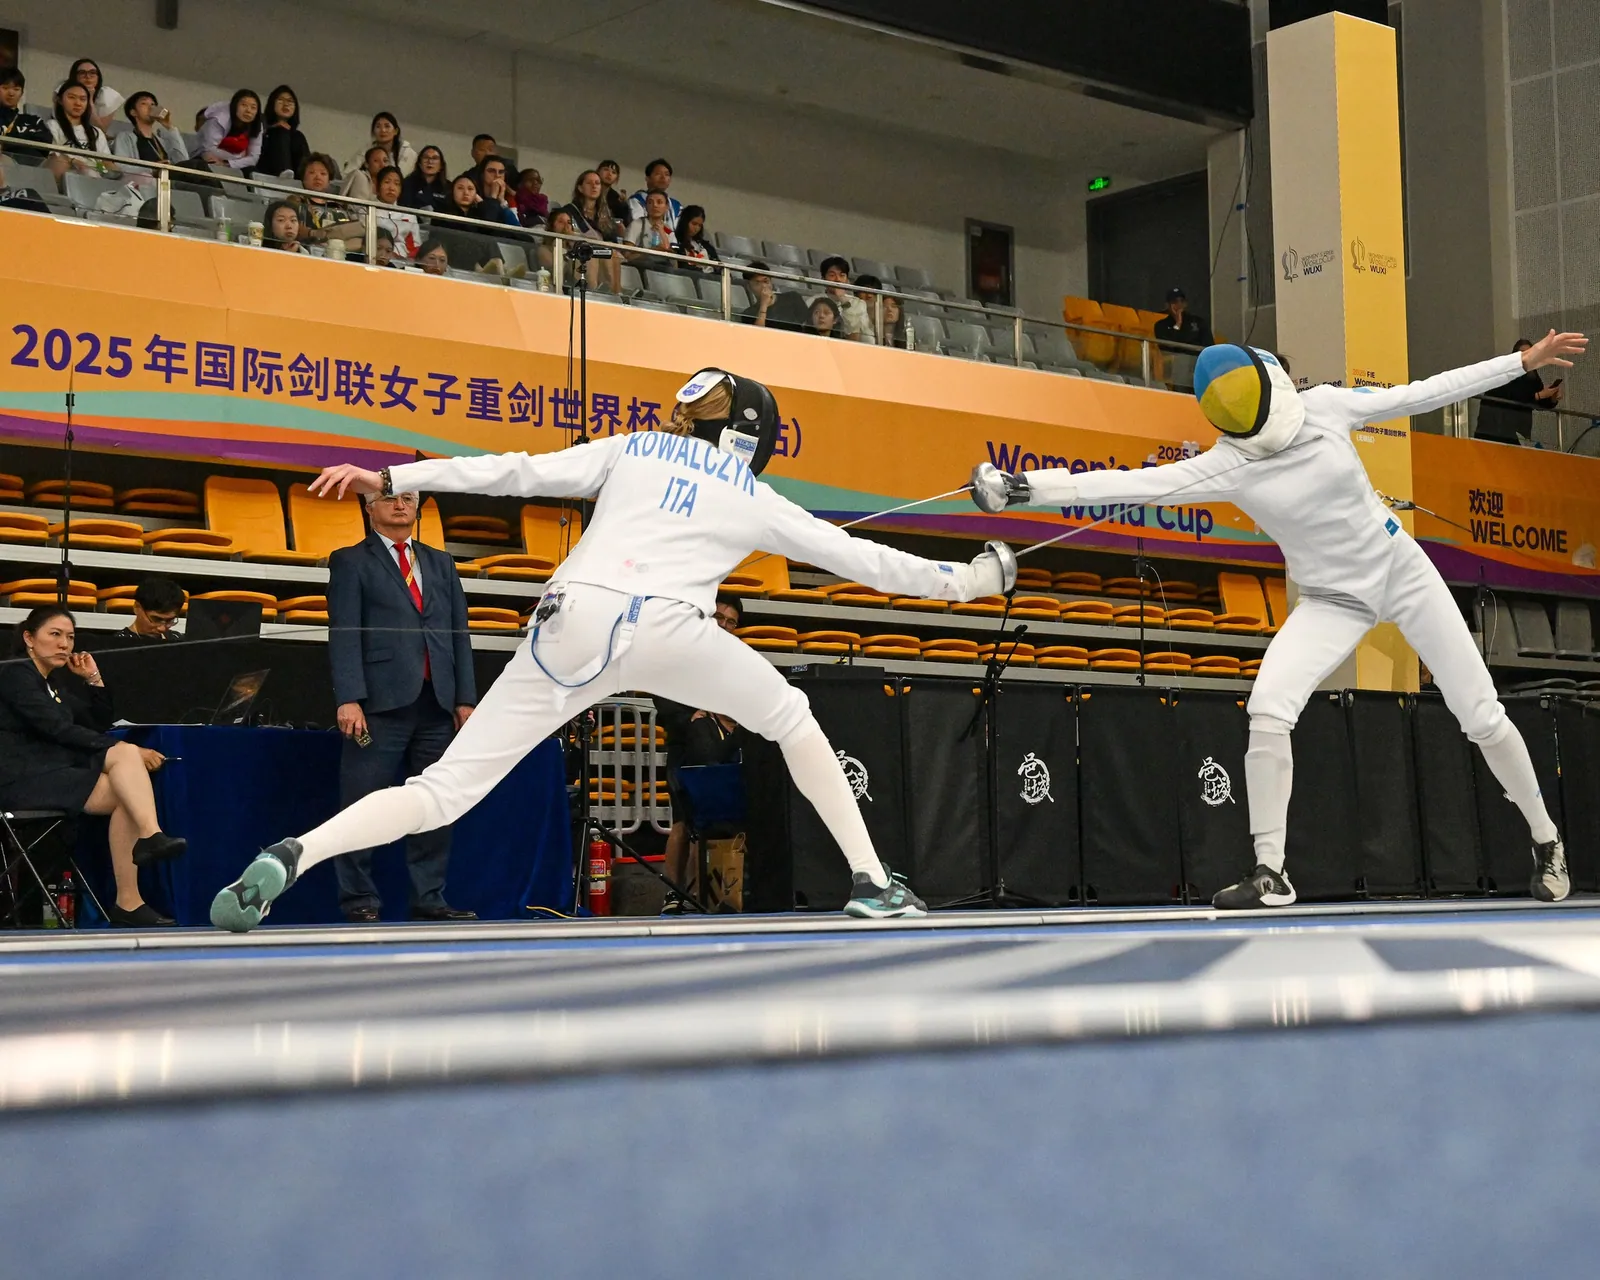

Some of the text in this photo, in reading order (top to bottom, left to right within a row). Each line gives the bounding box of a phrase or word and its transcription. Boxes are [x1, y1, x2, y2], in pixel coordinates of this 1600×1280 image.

[1303, 265, 1322, 275] WUXI
[1370, 265, 1387, 275] WUXI
[1299, 376, 1308, 385] FIE
[1366, 370, 1375, 379] FIE
[986, 440, 1130, 475] Women'
[658, 475, 699, 519] ITA
[1469, 488, 1504, 518] 欢迎
[1157, 504, 1214, 541] Cup
[1469, 518, 1568, 553] WELCOME
